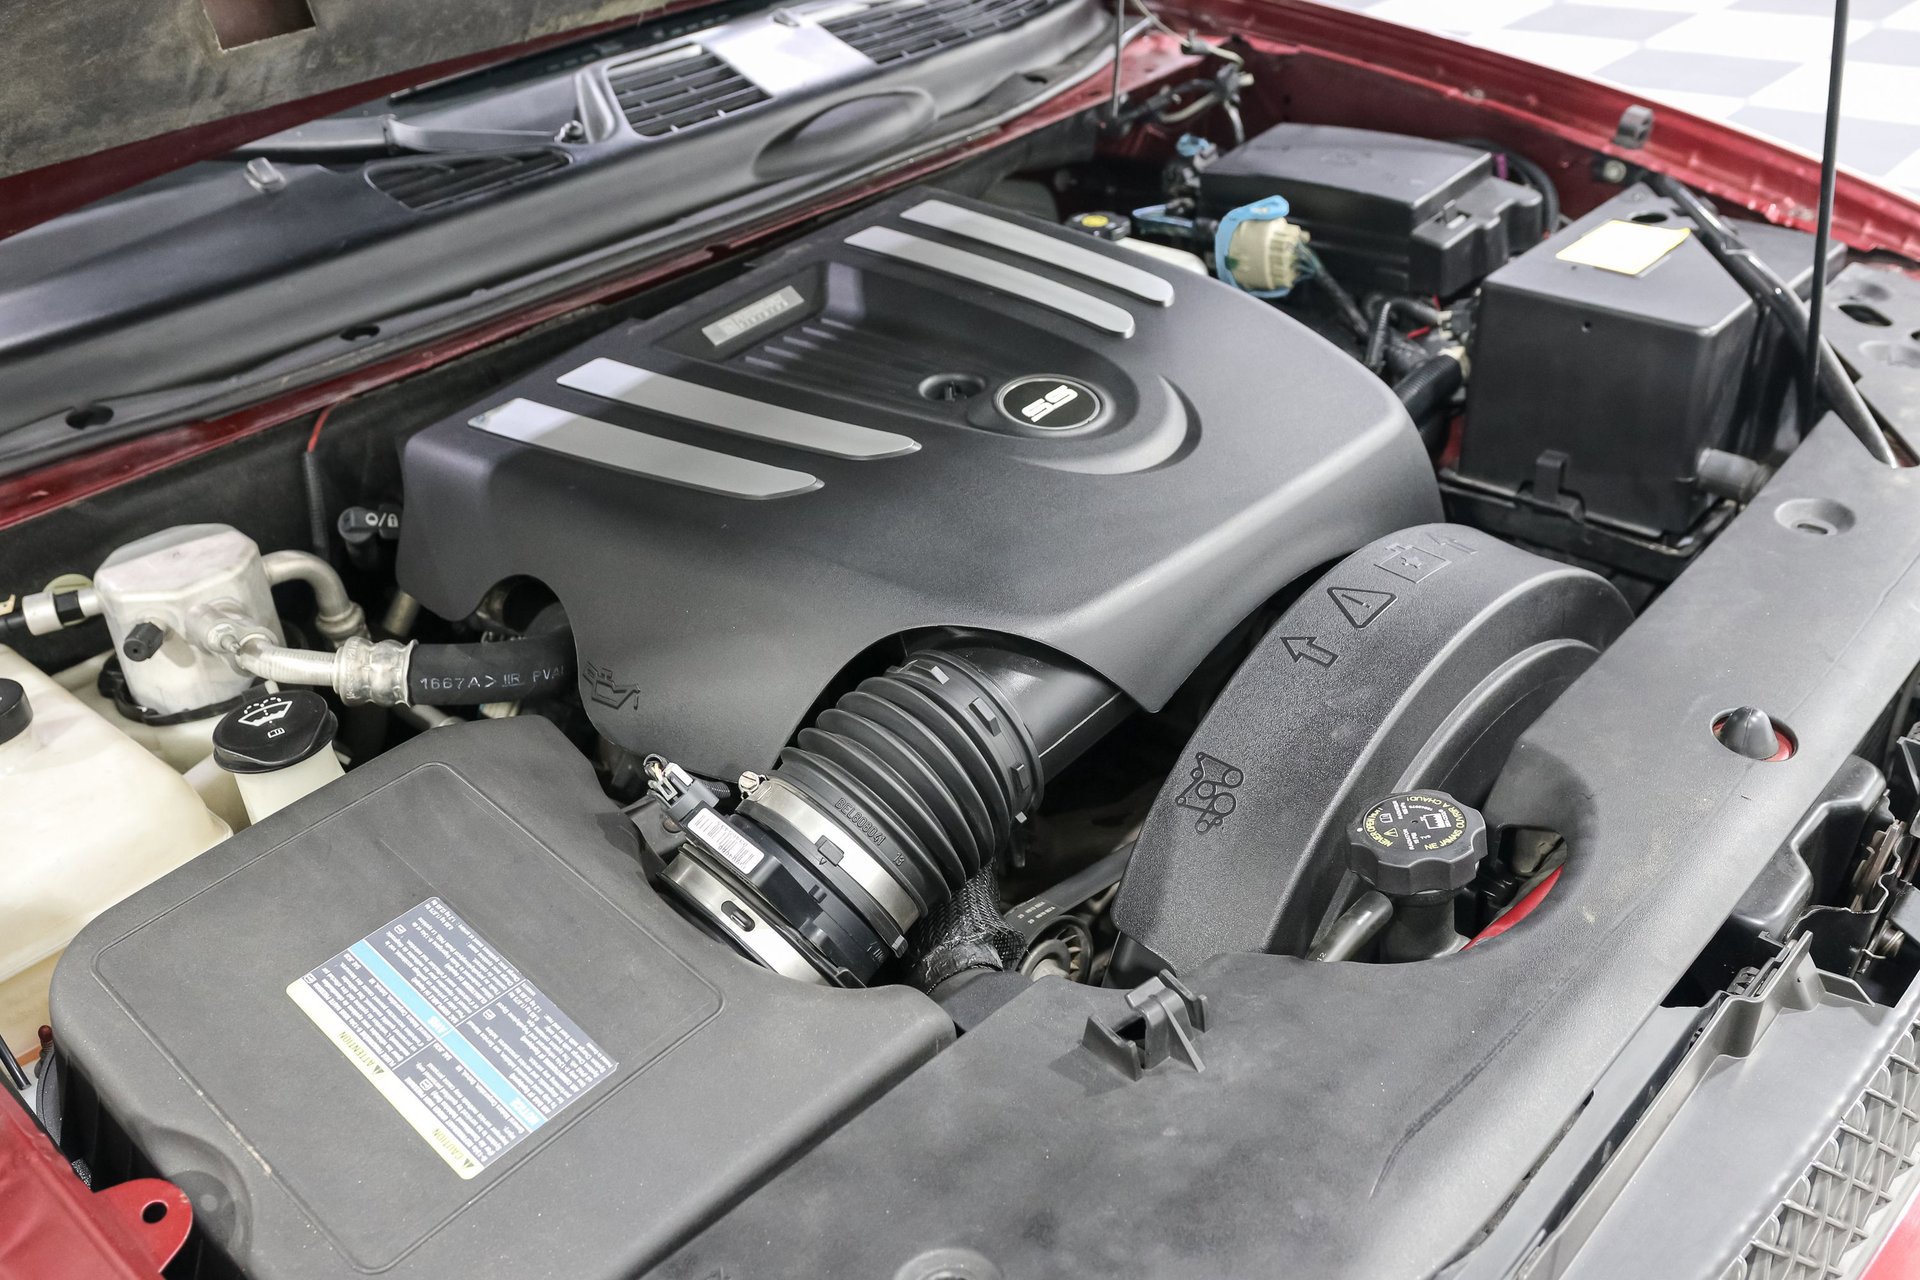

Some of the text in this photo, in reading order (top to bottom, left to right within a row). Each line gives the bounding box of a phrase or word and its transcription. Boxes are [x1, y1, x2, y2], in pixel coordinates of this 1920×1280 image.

[1022, 384, 1078, 422] SS
[1424, 842, 1439, 850] NE
[1447, 806, 1465, 829] OUVRIR
[337, 1030, 375, 1068] ATTENTION
[431, 1127, 464, 1160] CAUTION
